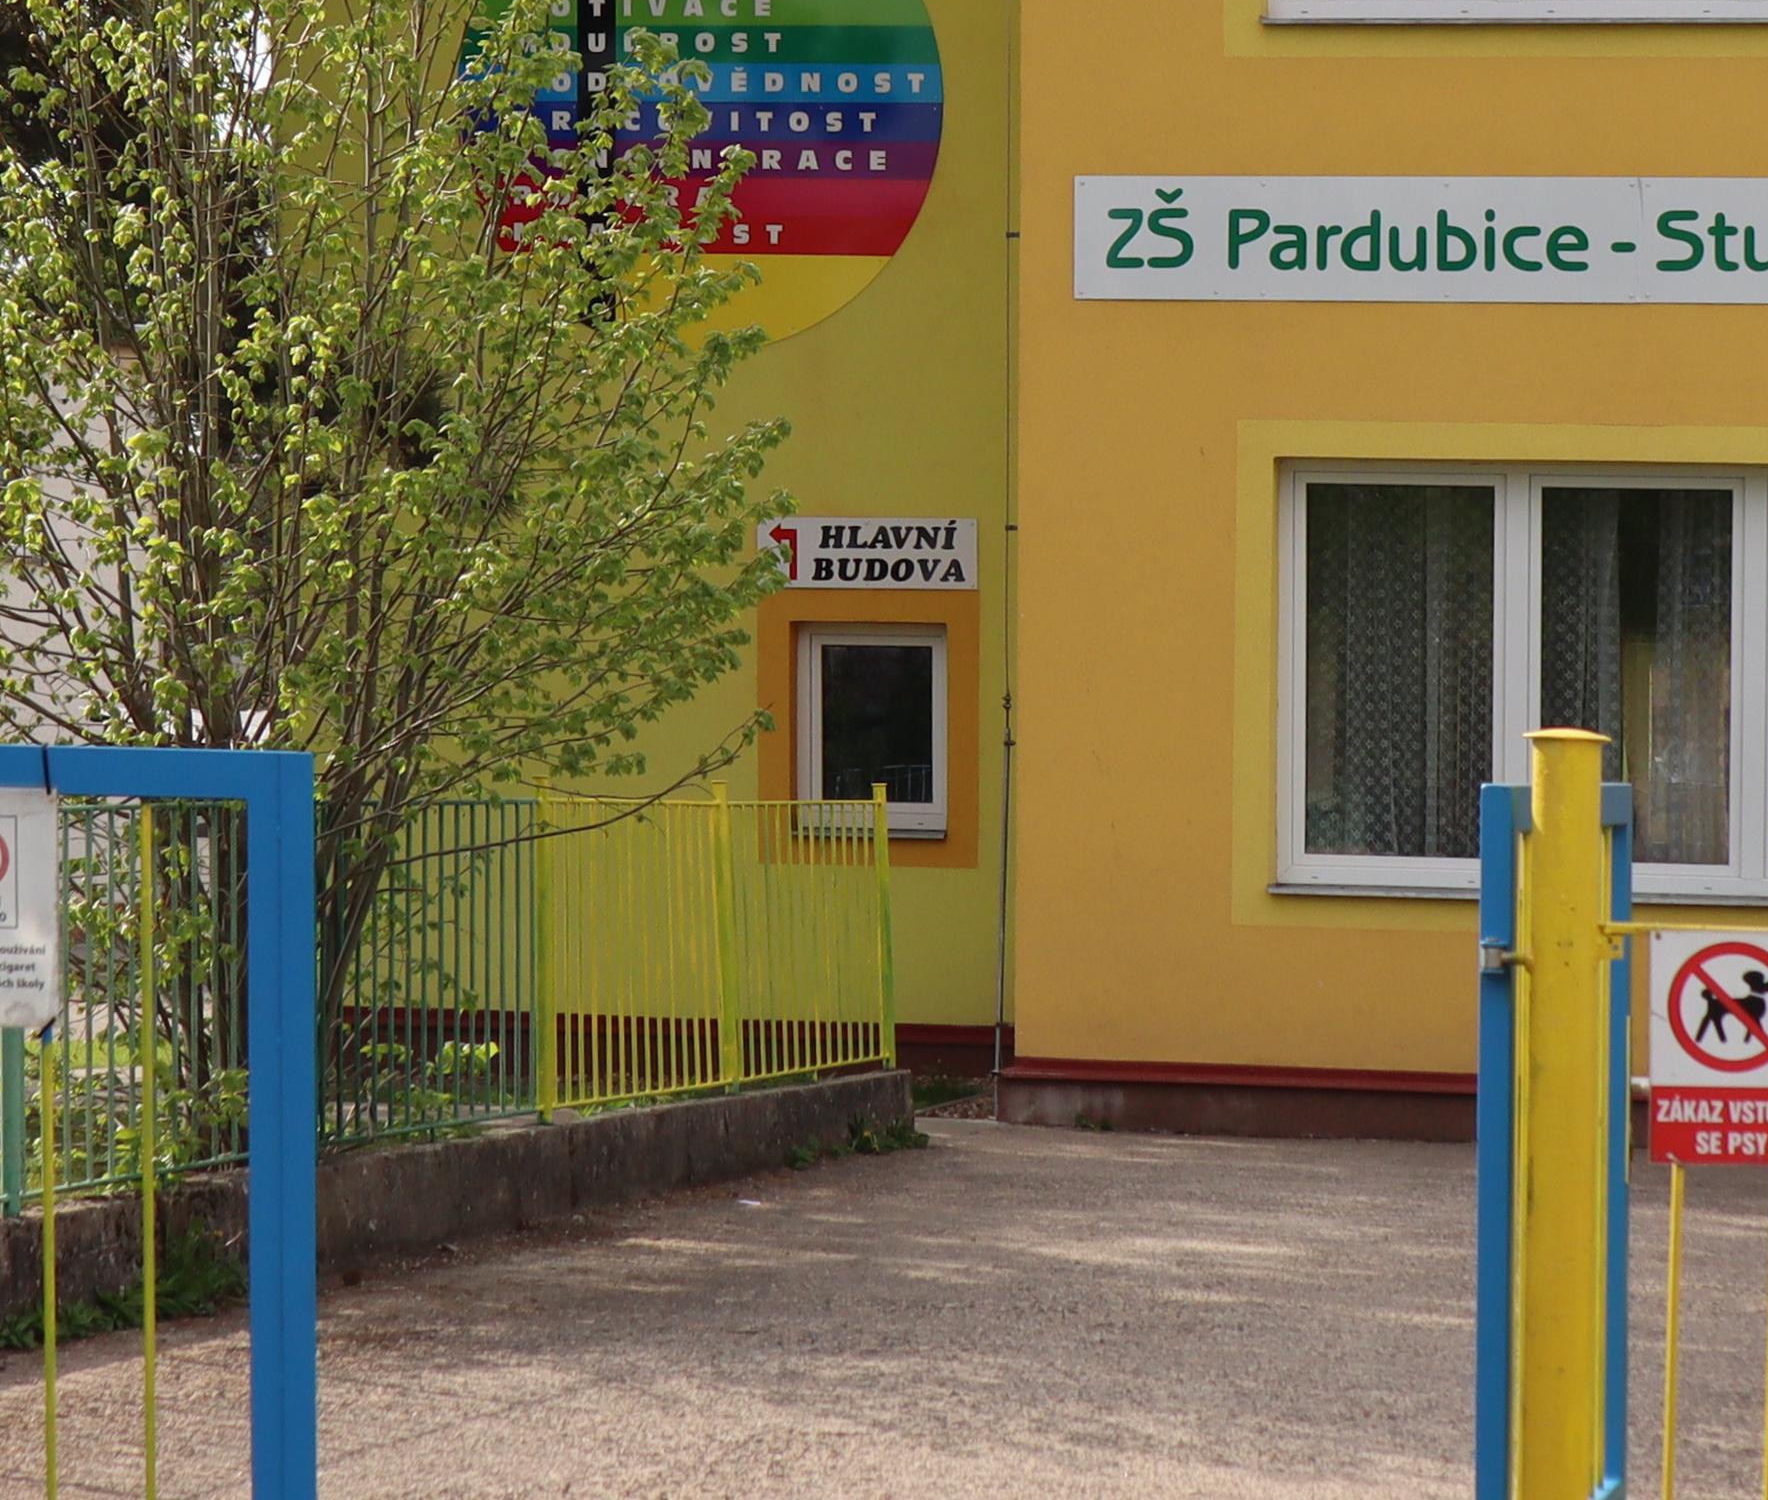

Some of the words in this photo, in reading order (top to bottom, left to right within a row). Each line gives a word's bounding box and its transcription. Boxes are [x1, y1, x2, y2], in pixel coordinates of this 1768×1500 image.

[549, 66, 924, 93] ODOVĚDNOST
[1105, 187, 1194, 268] ZŠ
[1227, 208, 1589, 272] Pardubice
[818, 520, 958, 550] HLAVNÍ
[811, 557, 966, 582] BUDOVA
[1656, 1094, 1724, 1124] ZÁKAZ
[1695, 1131, 1723, 1156] SE
[1727, 1132, 1768, 1156] PSY
